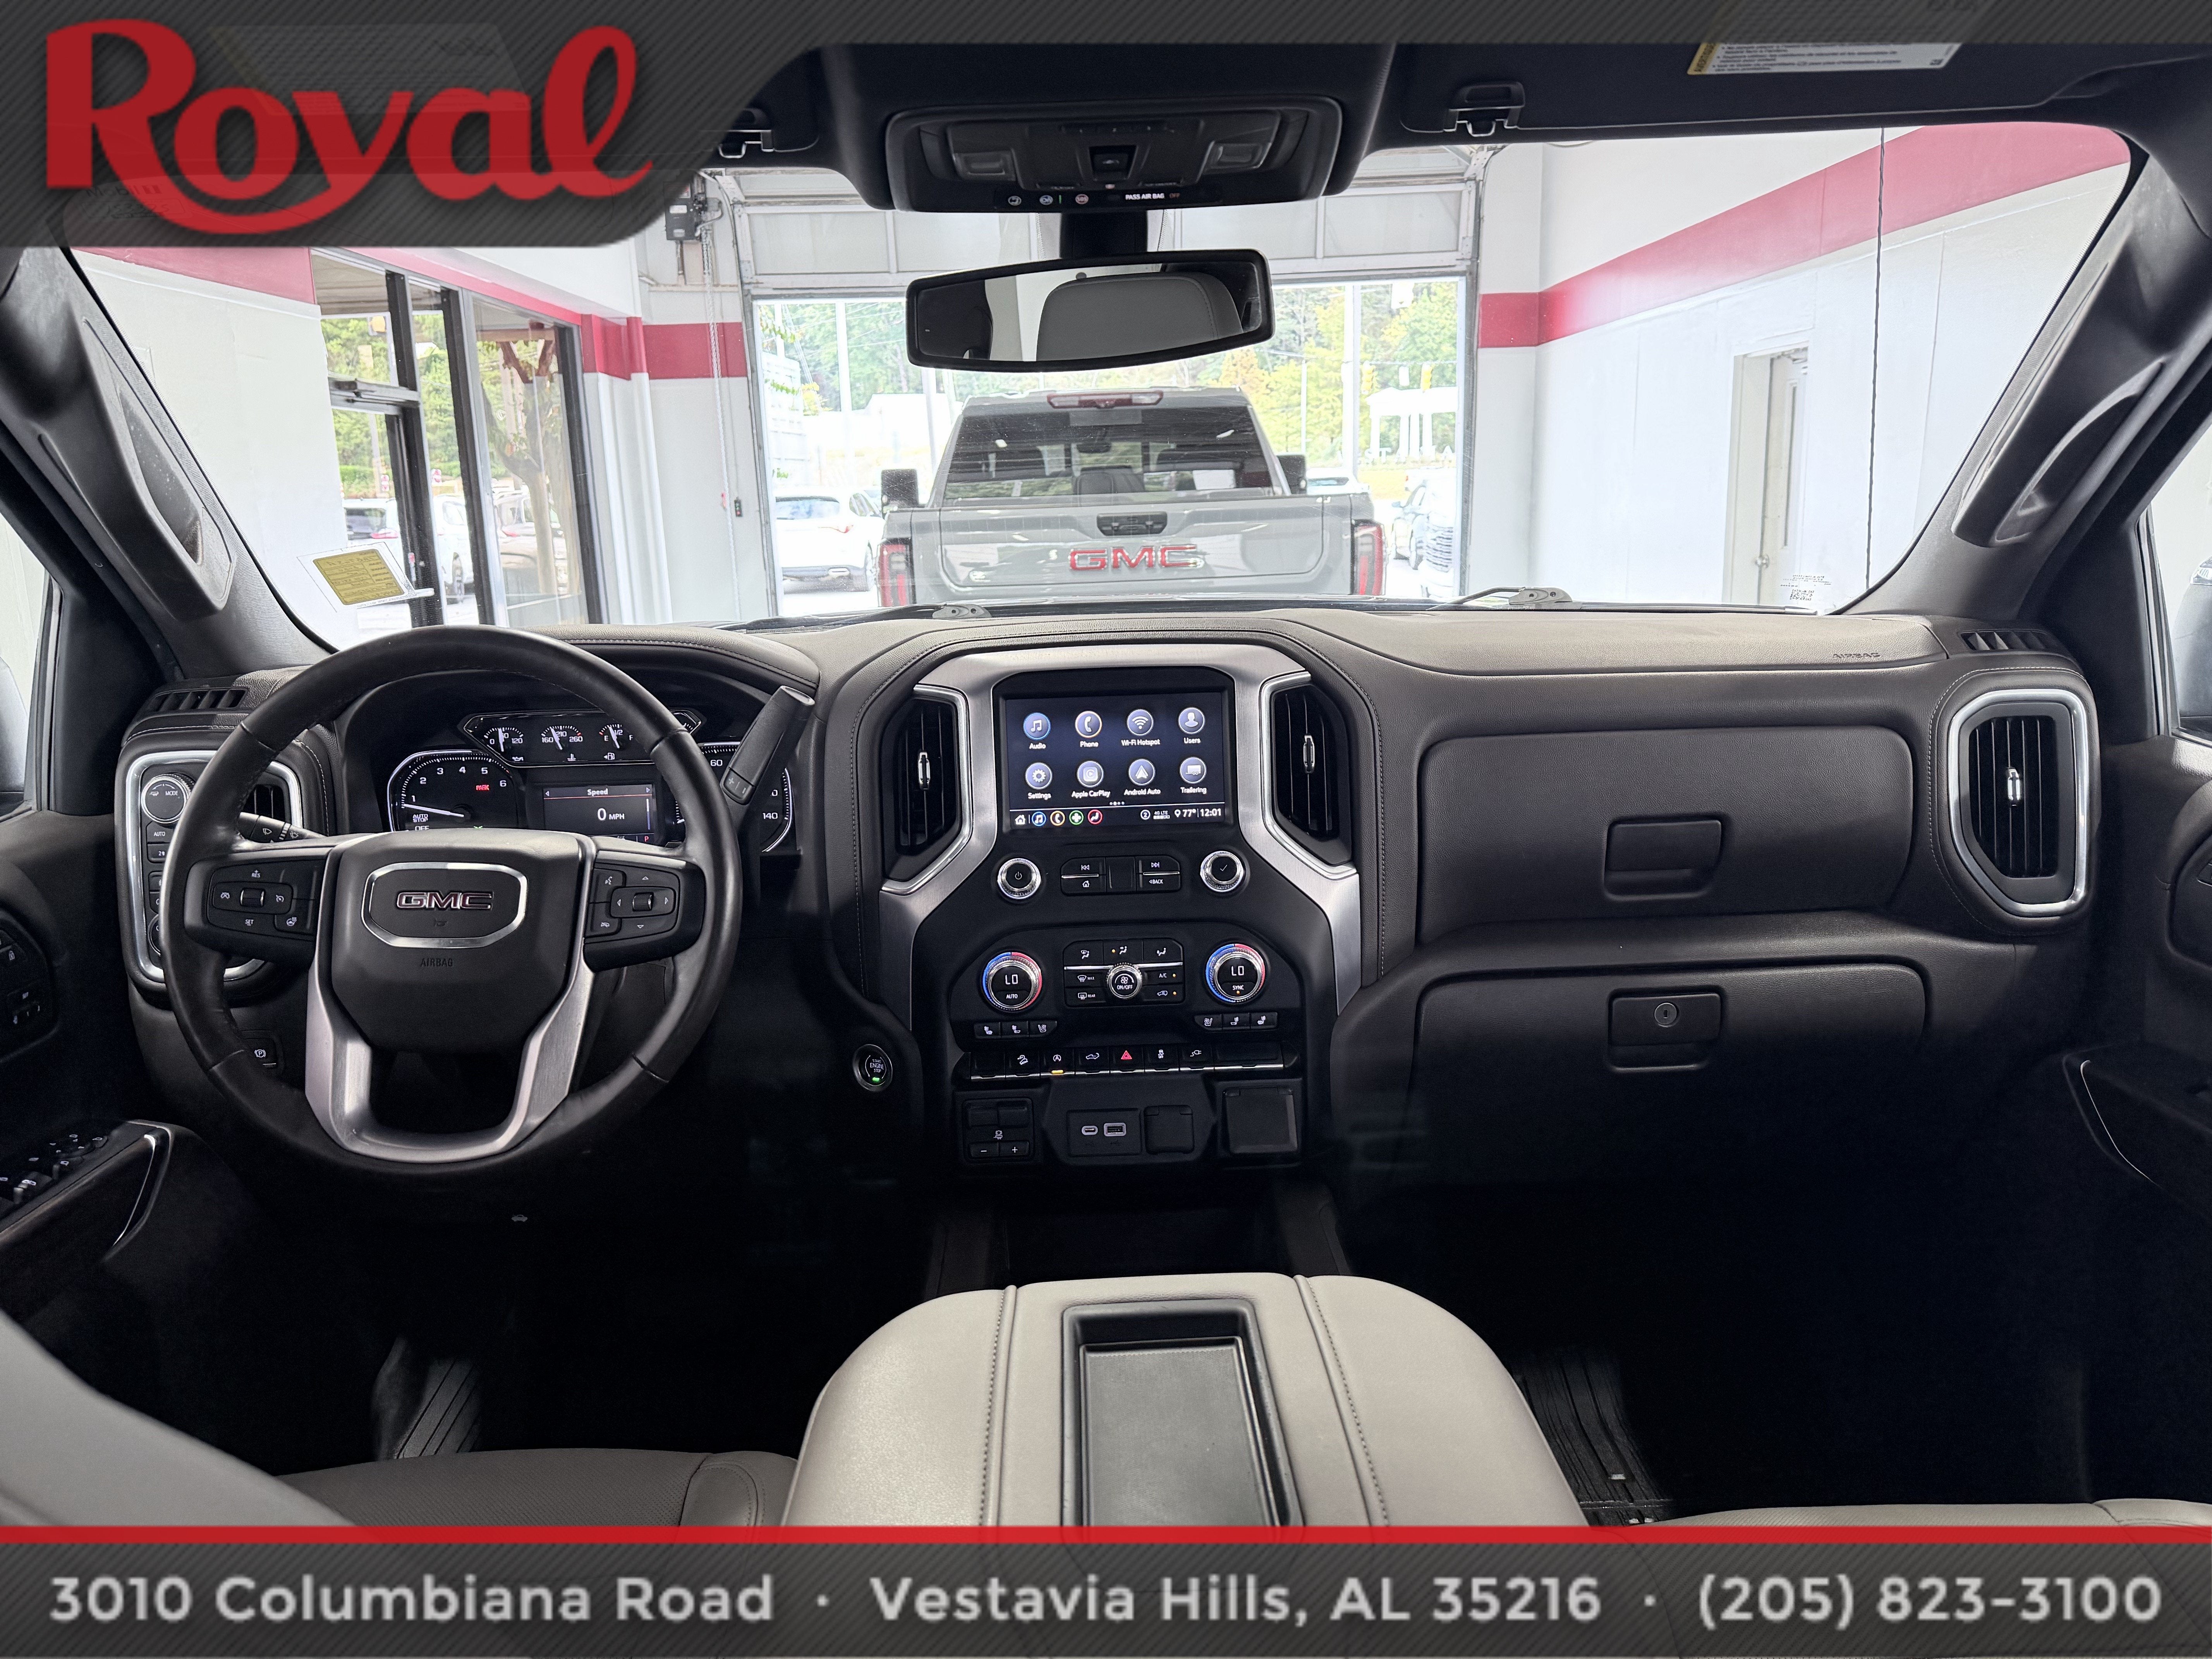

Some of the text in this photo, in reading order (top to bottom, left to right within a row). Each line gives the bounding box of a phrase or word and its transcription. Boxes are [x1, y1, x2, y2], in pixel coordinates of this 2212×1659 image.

[1069, 544, 1197, 570] GMC
[598, 808, 606, 820] 0
[1183, 809, 1196, 817] 77°
[1200, 808, 1221, 817] 12:01
[397, 892, 492, 910] GMC
[421, 958, 453, 967] AIRBAG
[1231, 966, 1244, 976] LO
[1005, 974, 1018, 984] LO
